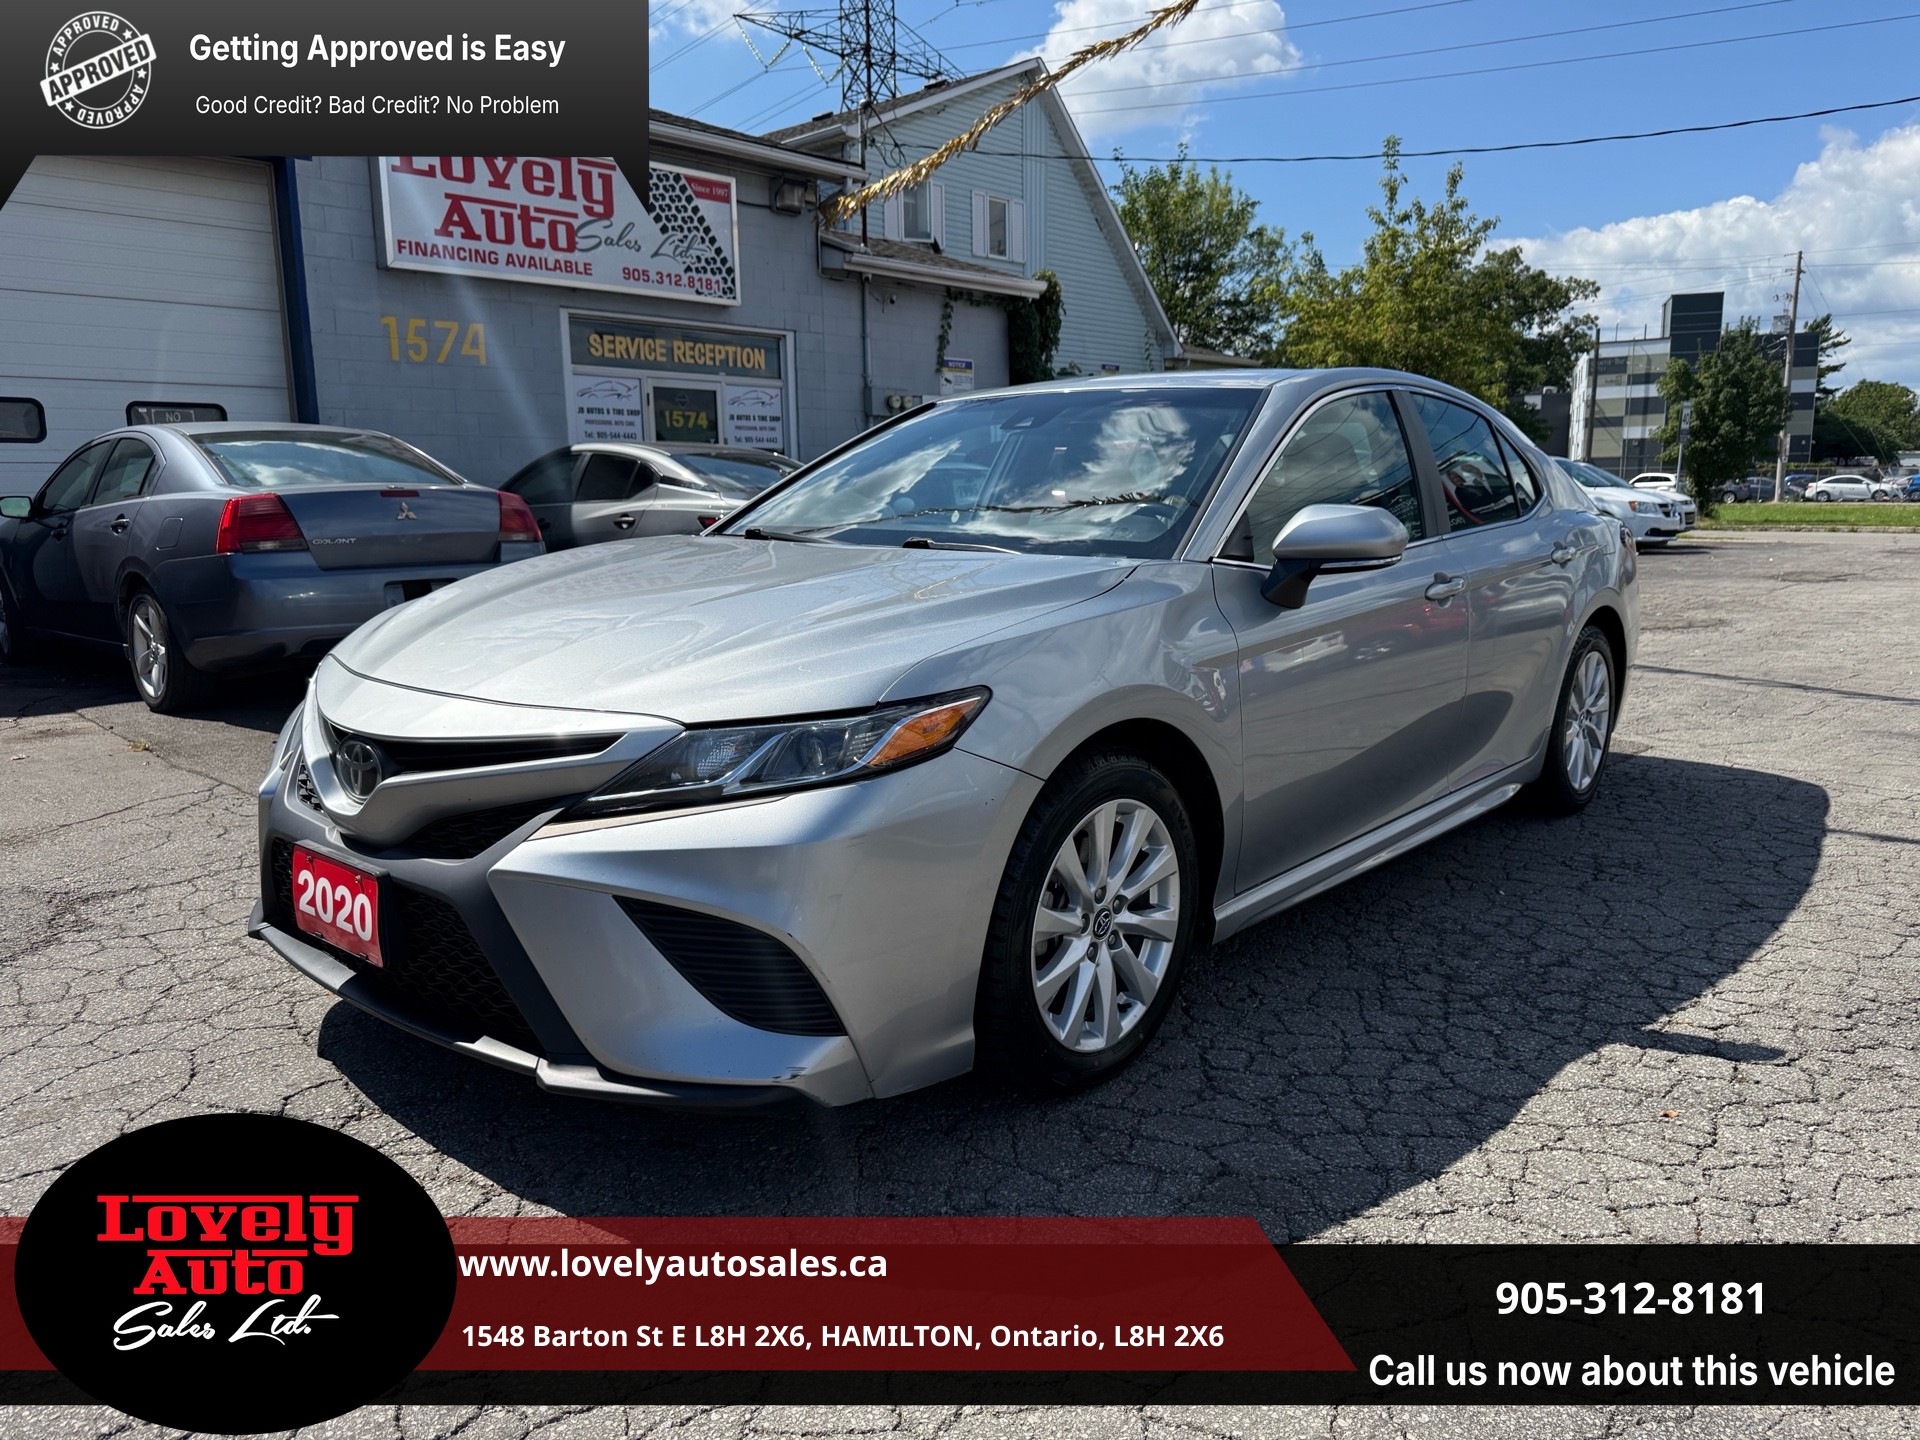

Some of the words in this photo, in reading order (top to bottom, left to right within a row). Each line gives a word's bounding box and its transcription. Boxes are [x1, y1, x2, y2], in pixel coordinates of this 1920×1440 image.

[434, 193, 578, 253] Auto
[575, 218, 641, 253] Sales
[397, 239, 499, 265] FINANCING
[505, 253, 593, 276] AVAILABLE
[622, 266, 721, 292] 905.312.8181
[380, 316, 487, 366] 1574
[588, 333, 667, 363] SERVICE
[672, 340, 766, 370] RECEPTION
[165, 412, 181, 422] NO
[664, 410, 708, 429] 1574
[297, 869, 373, 942] 2020
